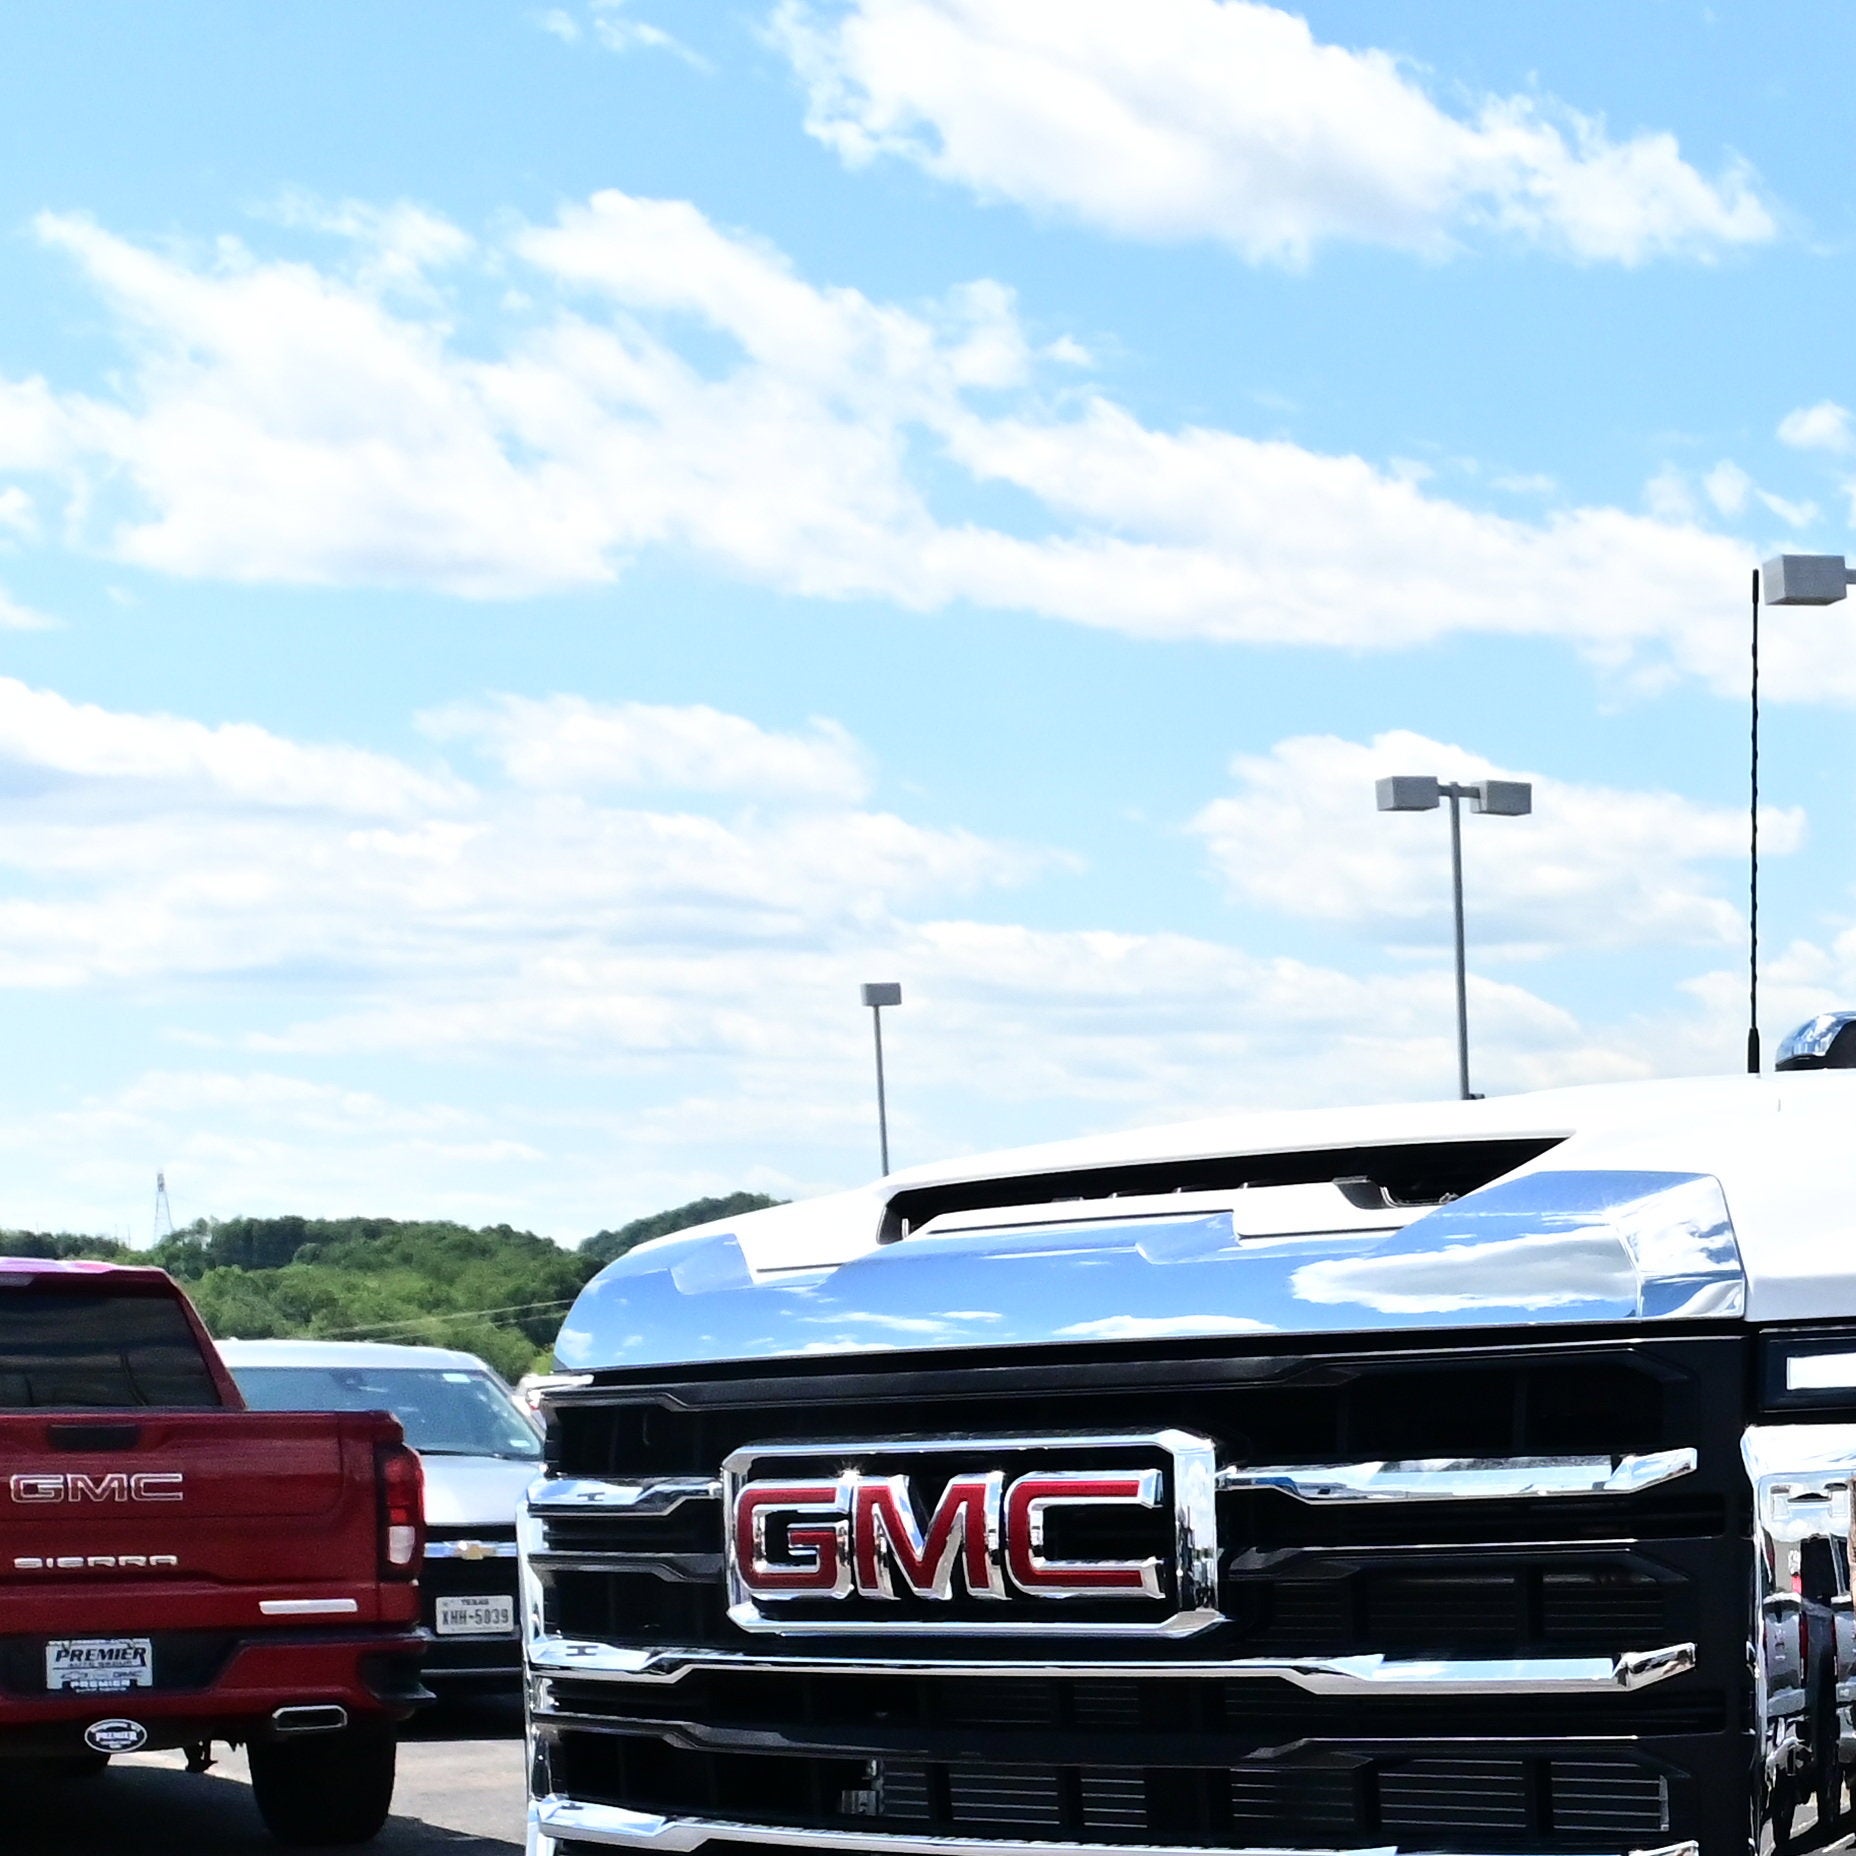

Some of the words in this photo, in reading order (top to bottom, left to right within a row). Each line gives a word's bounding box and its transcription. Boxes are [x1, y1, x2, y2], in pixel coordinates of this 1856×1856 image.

[10, 1473, 183, 1502] GMC
[733, 1470, 1166, 1601] GMC
[13, 1555, 178, 1569] SIERRA
[55, 1647, 147, 1667] PREMIER
